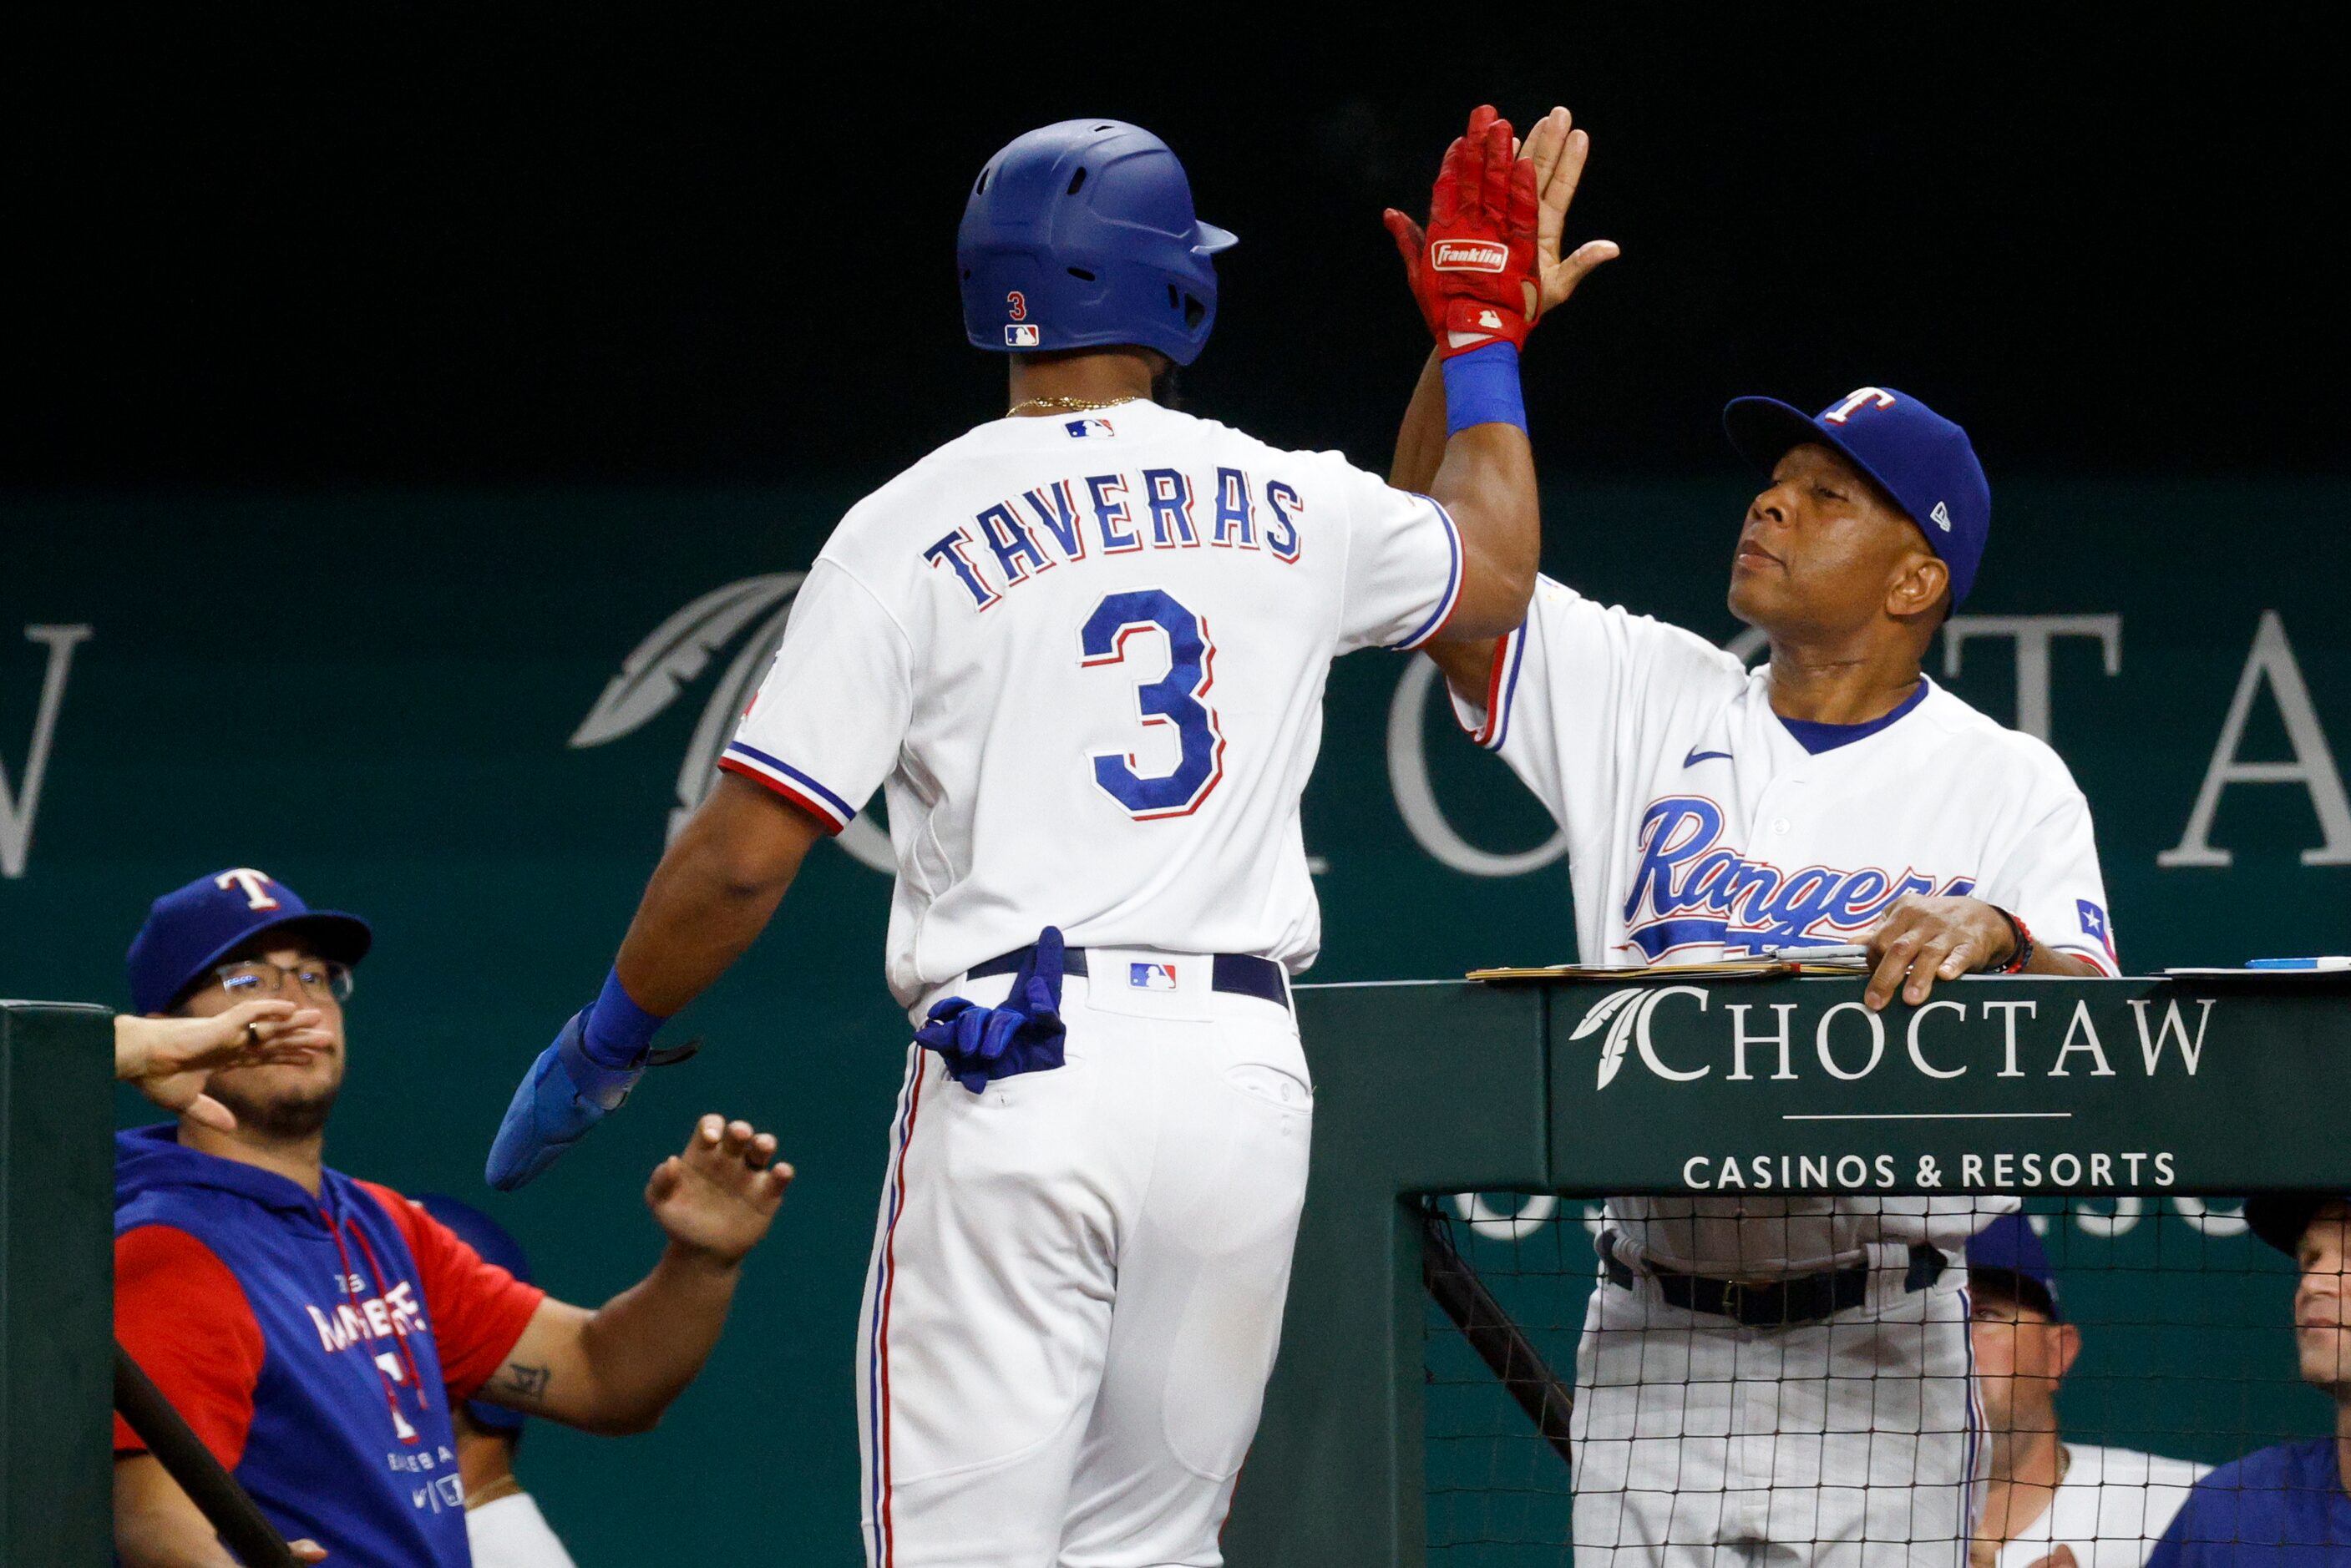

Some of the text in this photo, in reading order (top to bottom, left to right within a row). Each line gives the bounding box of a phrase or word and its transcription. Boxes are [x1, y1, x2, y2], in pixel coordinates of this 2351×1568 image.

[1006, 291, 1026, 321] 3
[1825, 387, 1897, 427] T
[921, 464, 1304, 612] TAVERAS
[1077, 586, 1226, 822] 3
[214, 867, 281, 913] T
[1635, 985, 2217, 1081] CHOCTAW
[1682, 1151, 2176, 1190] CASINOS & RESORTS
